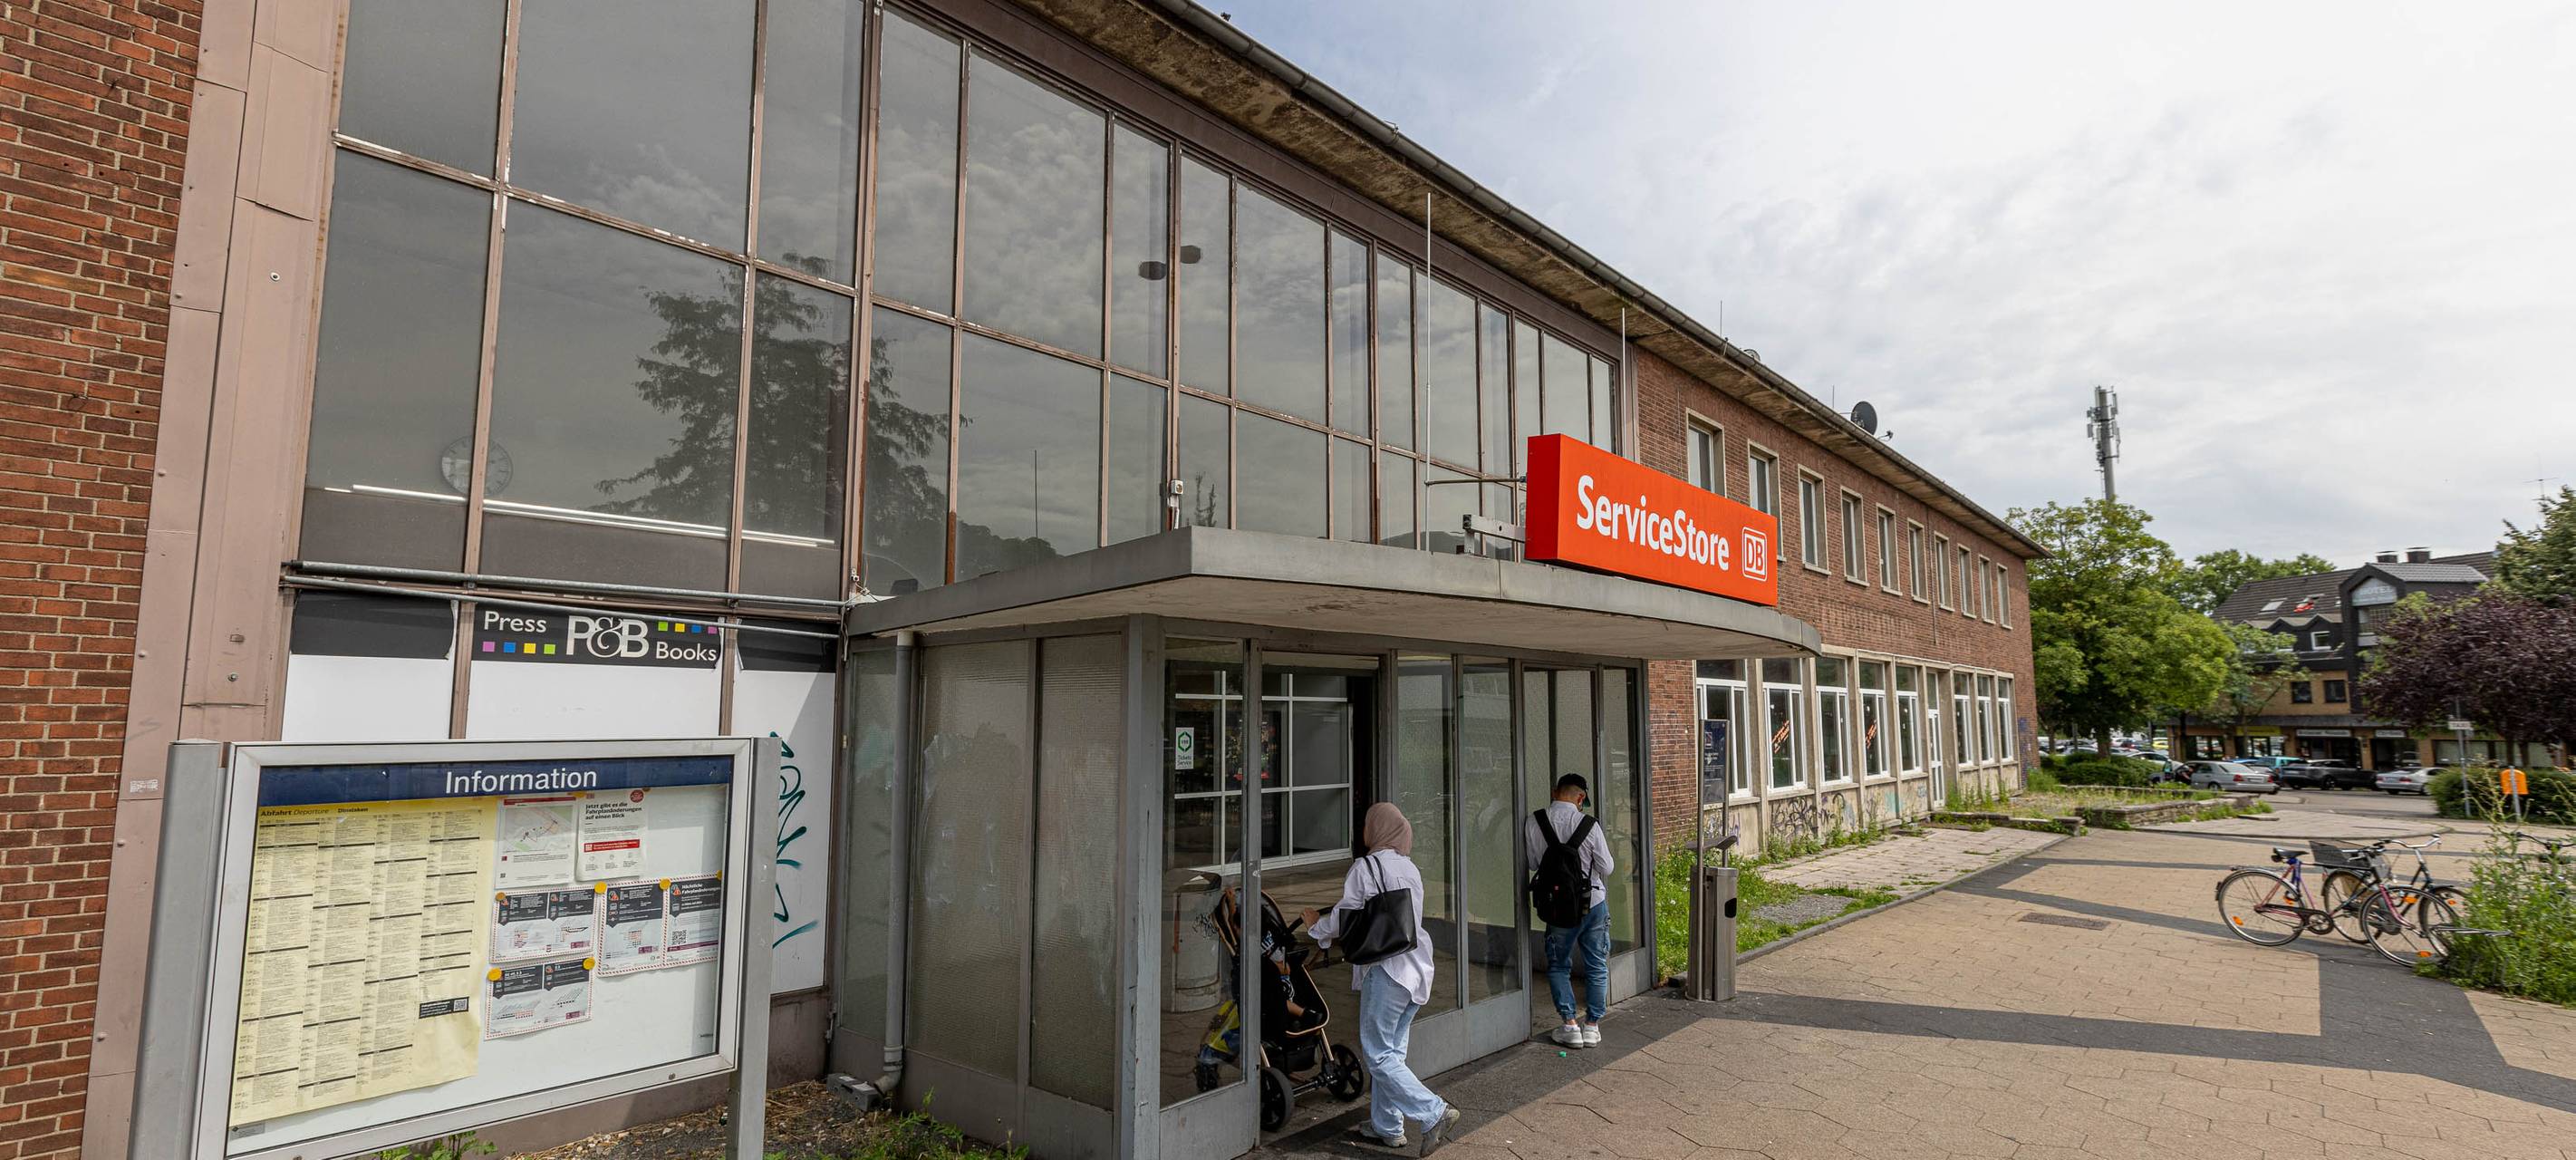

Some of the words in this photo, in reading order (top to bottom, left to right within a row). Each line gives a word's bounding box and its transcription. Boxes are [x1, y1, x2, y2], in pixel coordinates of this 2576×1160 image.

[1577, 475, 1730, 571] ServiceStore
[1745, 532, 1766, 575] DB
[484, 610, 547, 633] Press
[565, 614, 650, 658] P&B
[656, 642, 717, 662] Books
[446, 768, 597, 794] Information
